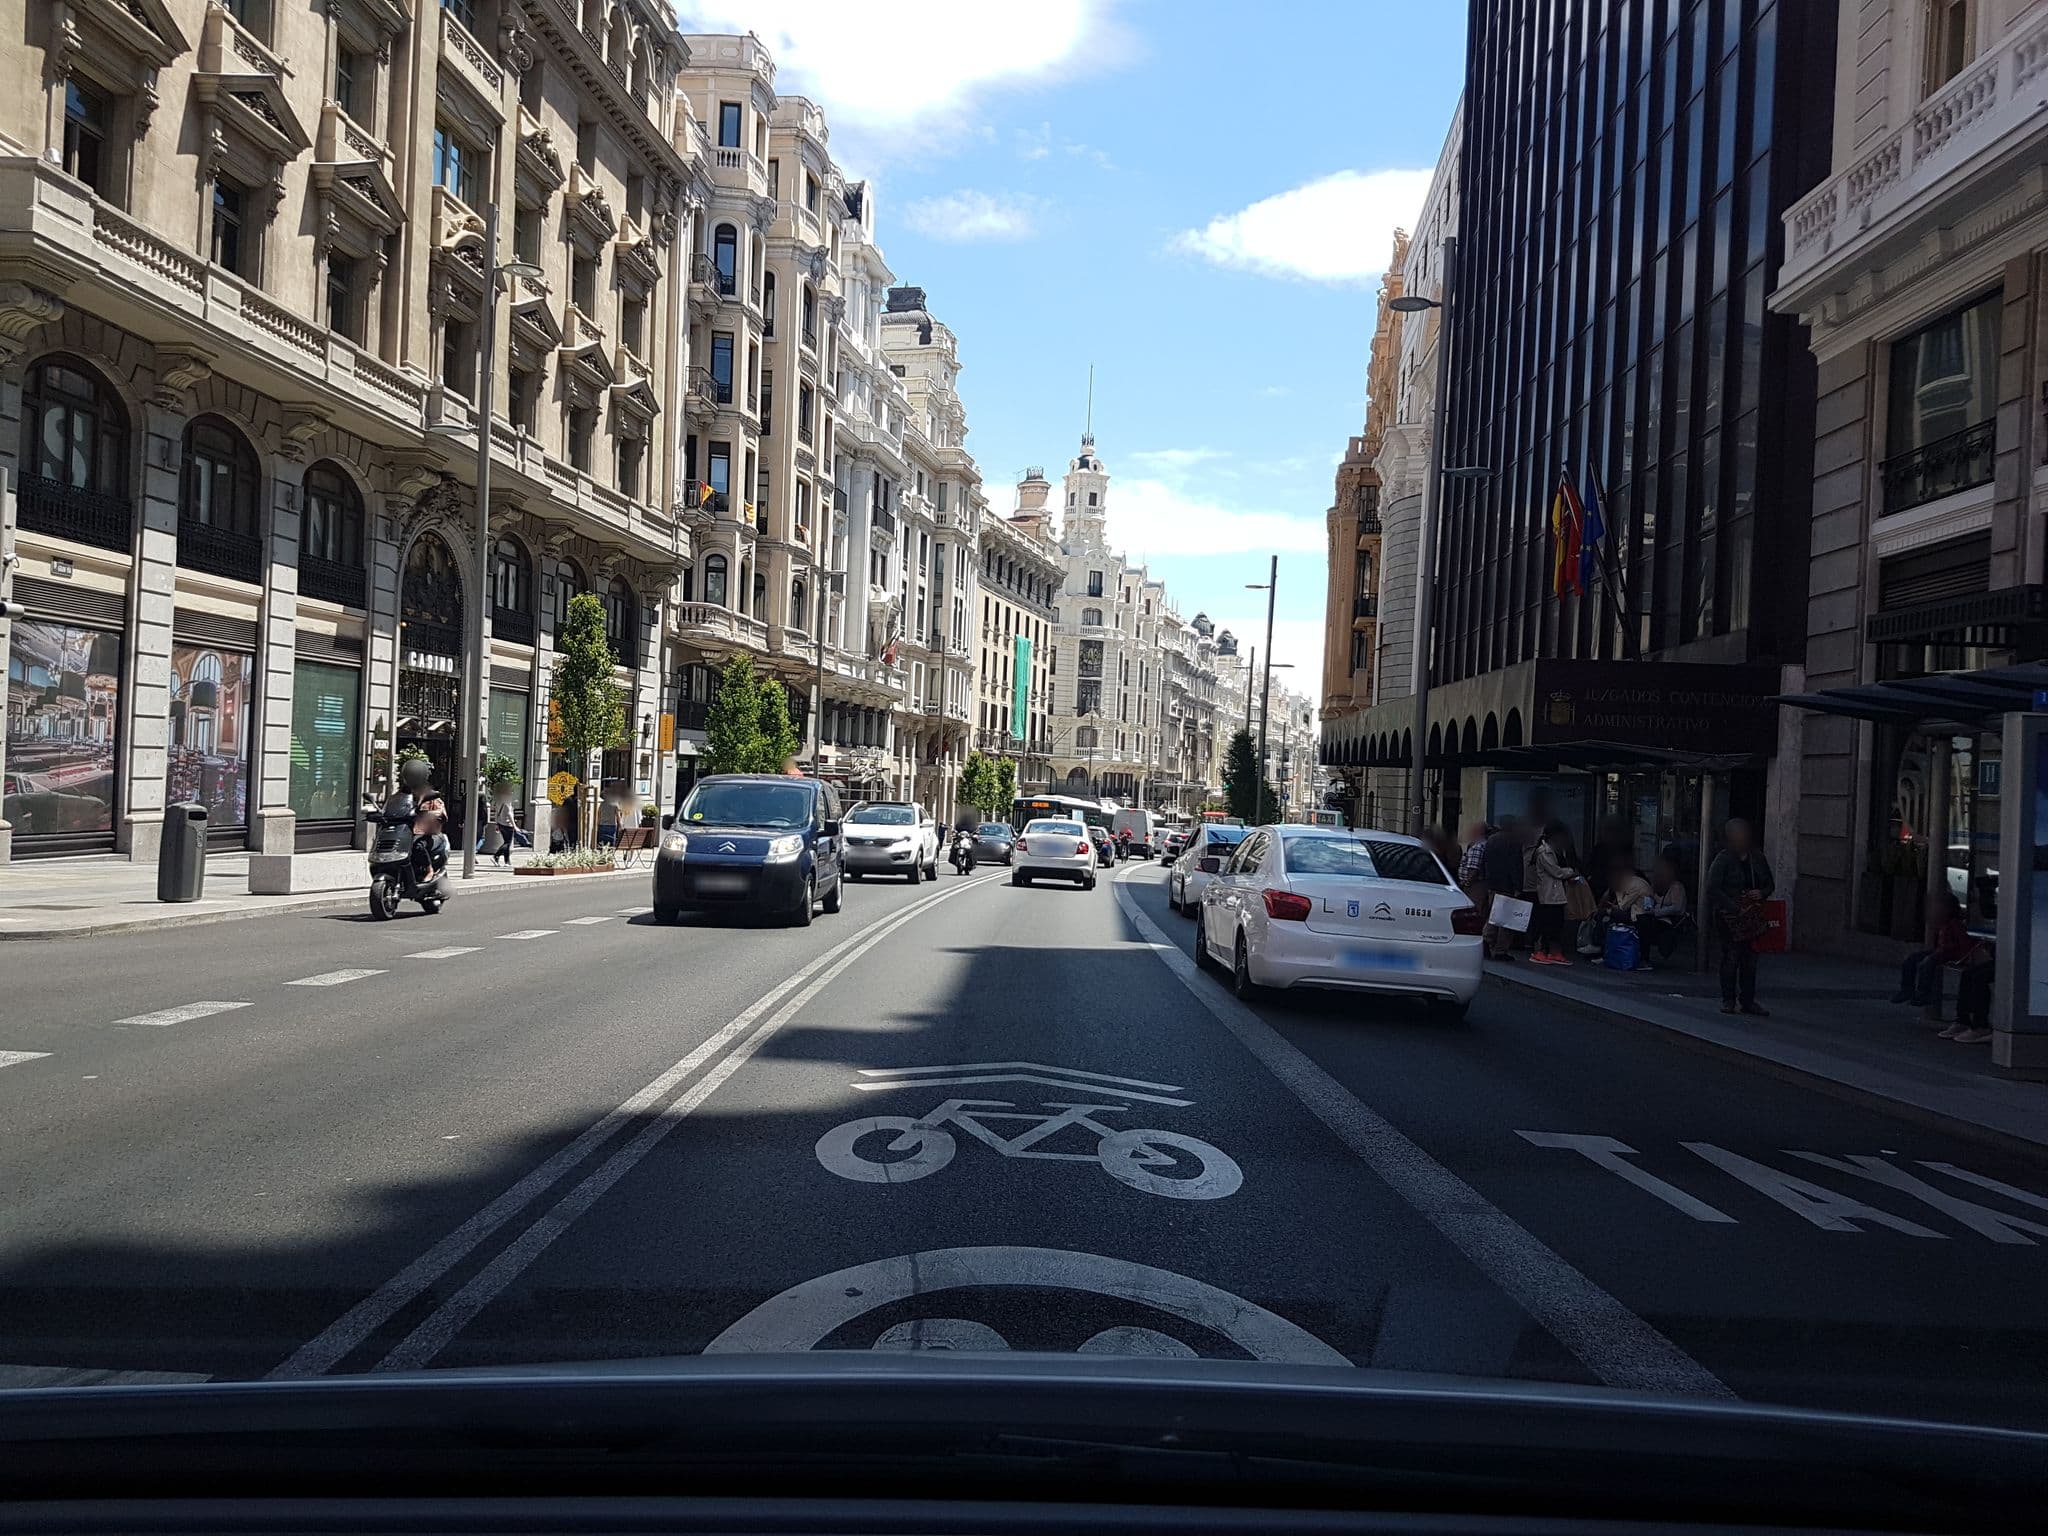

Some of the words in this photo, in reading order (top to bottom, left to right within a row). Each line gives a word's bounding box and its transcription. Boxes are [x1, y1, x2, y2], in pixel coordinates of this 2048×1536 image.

[409, 650, 454, 673] CASINO
[1317, 813, 1335, 825] TAXI
[1323, 898, 1335, 914] L
